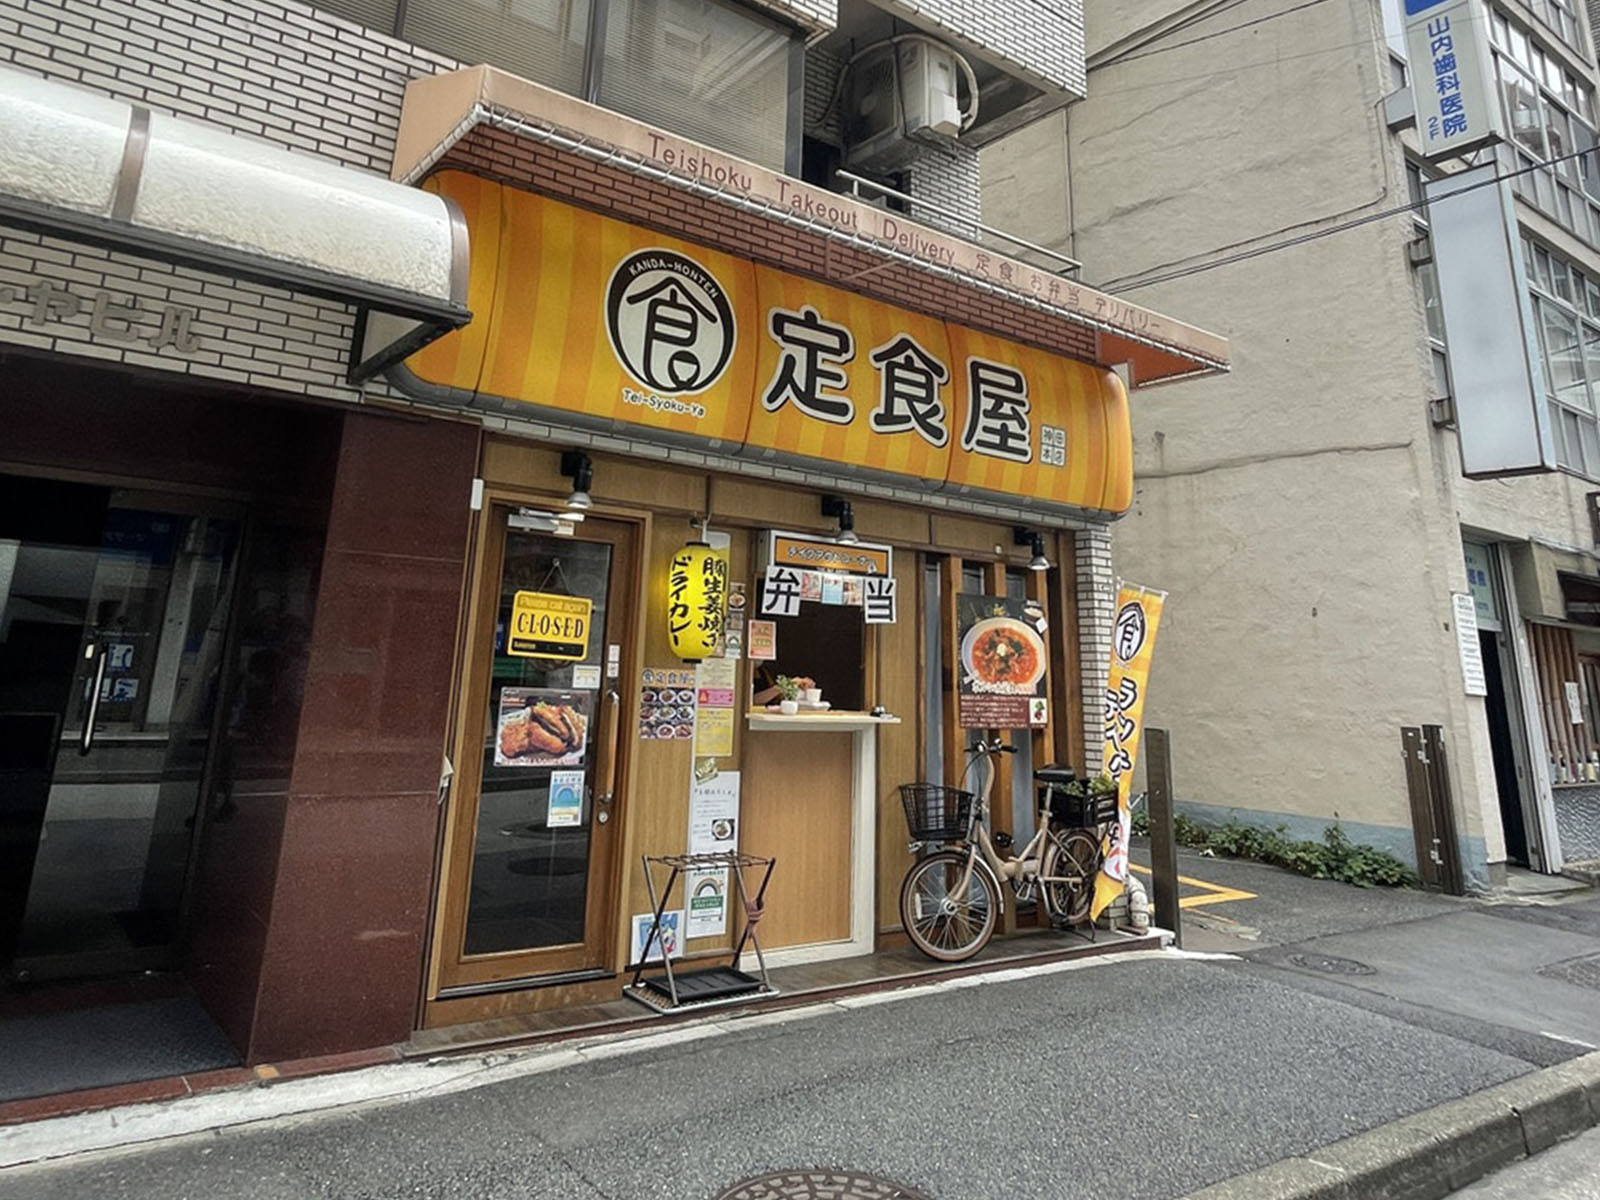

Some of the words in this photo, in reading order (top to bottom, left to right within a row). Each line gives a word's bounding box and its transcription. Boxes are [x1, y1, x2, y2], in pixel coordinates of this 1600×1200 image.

[1427, 15, 1468, 139] 山内歯科医院
[1427, 116, 1440, 141] 2F
[647, 132, 753, 192] Teishoku
[776, 178, 858, 229] Takeout
[883, 219, 956, 264] Delivery
[975, 253, 1013, 284] 定食
[629, 258, 719, 299] KANDA-HONTEN
[624, 389, 705, 416] Tei-Syoku-Ya
[764, 307, 1030, 460] 定食屋
[670, 555, 692, 647] ドライカレー
